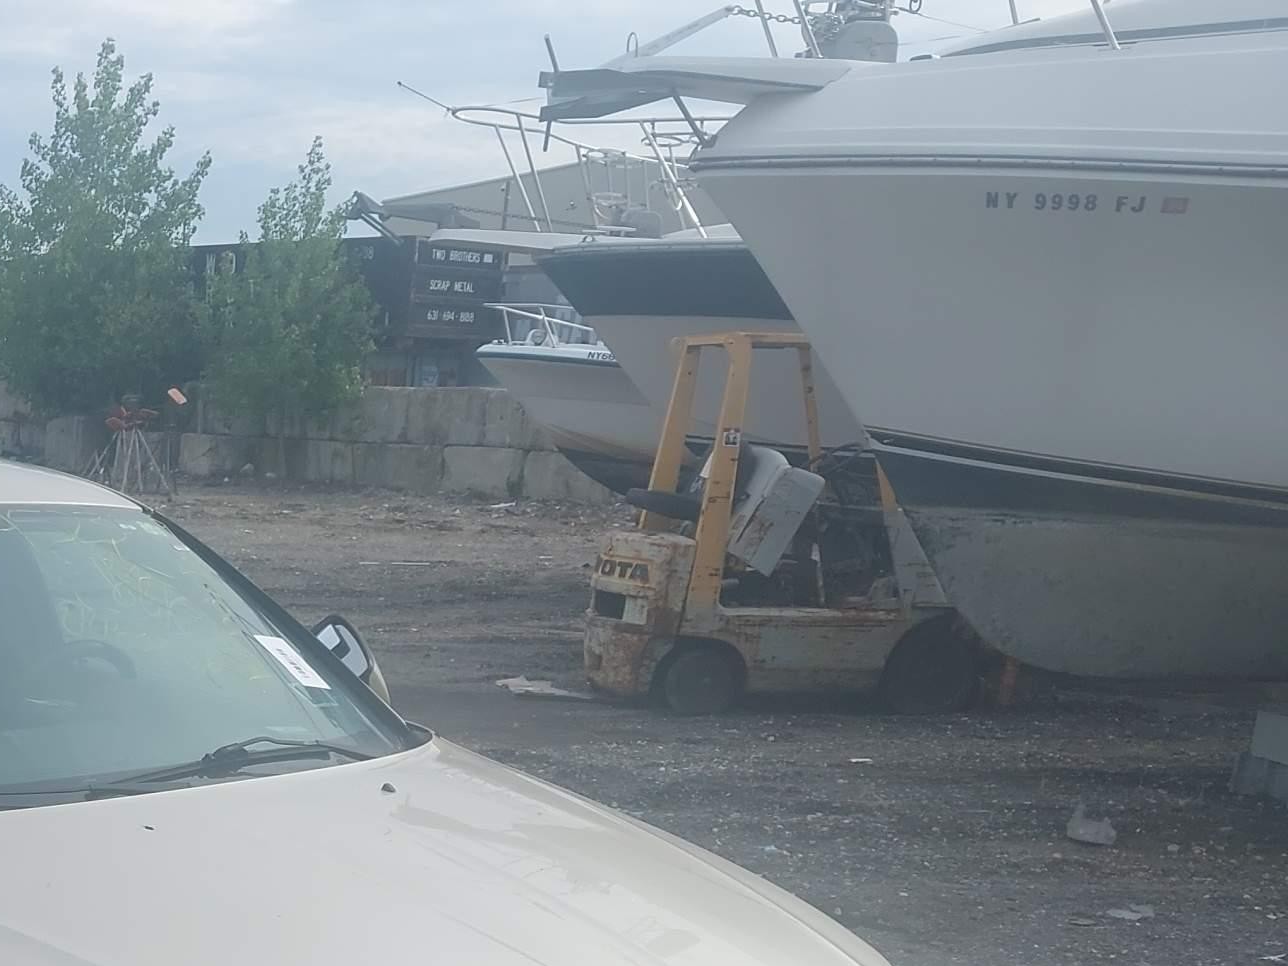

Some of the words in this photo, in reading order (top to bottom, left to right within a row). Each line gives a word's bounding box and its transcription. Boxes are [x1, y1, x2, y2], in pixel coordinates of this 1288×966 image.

[985, 191, 1018, 209] NY
[1034, 193, 1097, 211] 9998
[1114, 196, 1147, 213] FJ
[432, 248, 446, 261] TWO
[429, 279, 451, 291] SCRAP
[454, 281, 475, 293] METAL
[596, 556, 649, 582] OTA
